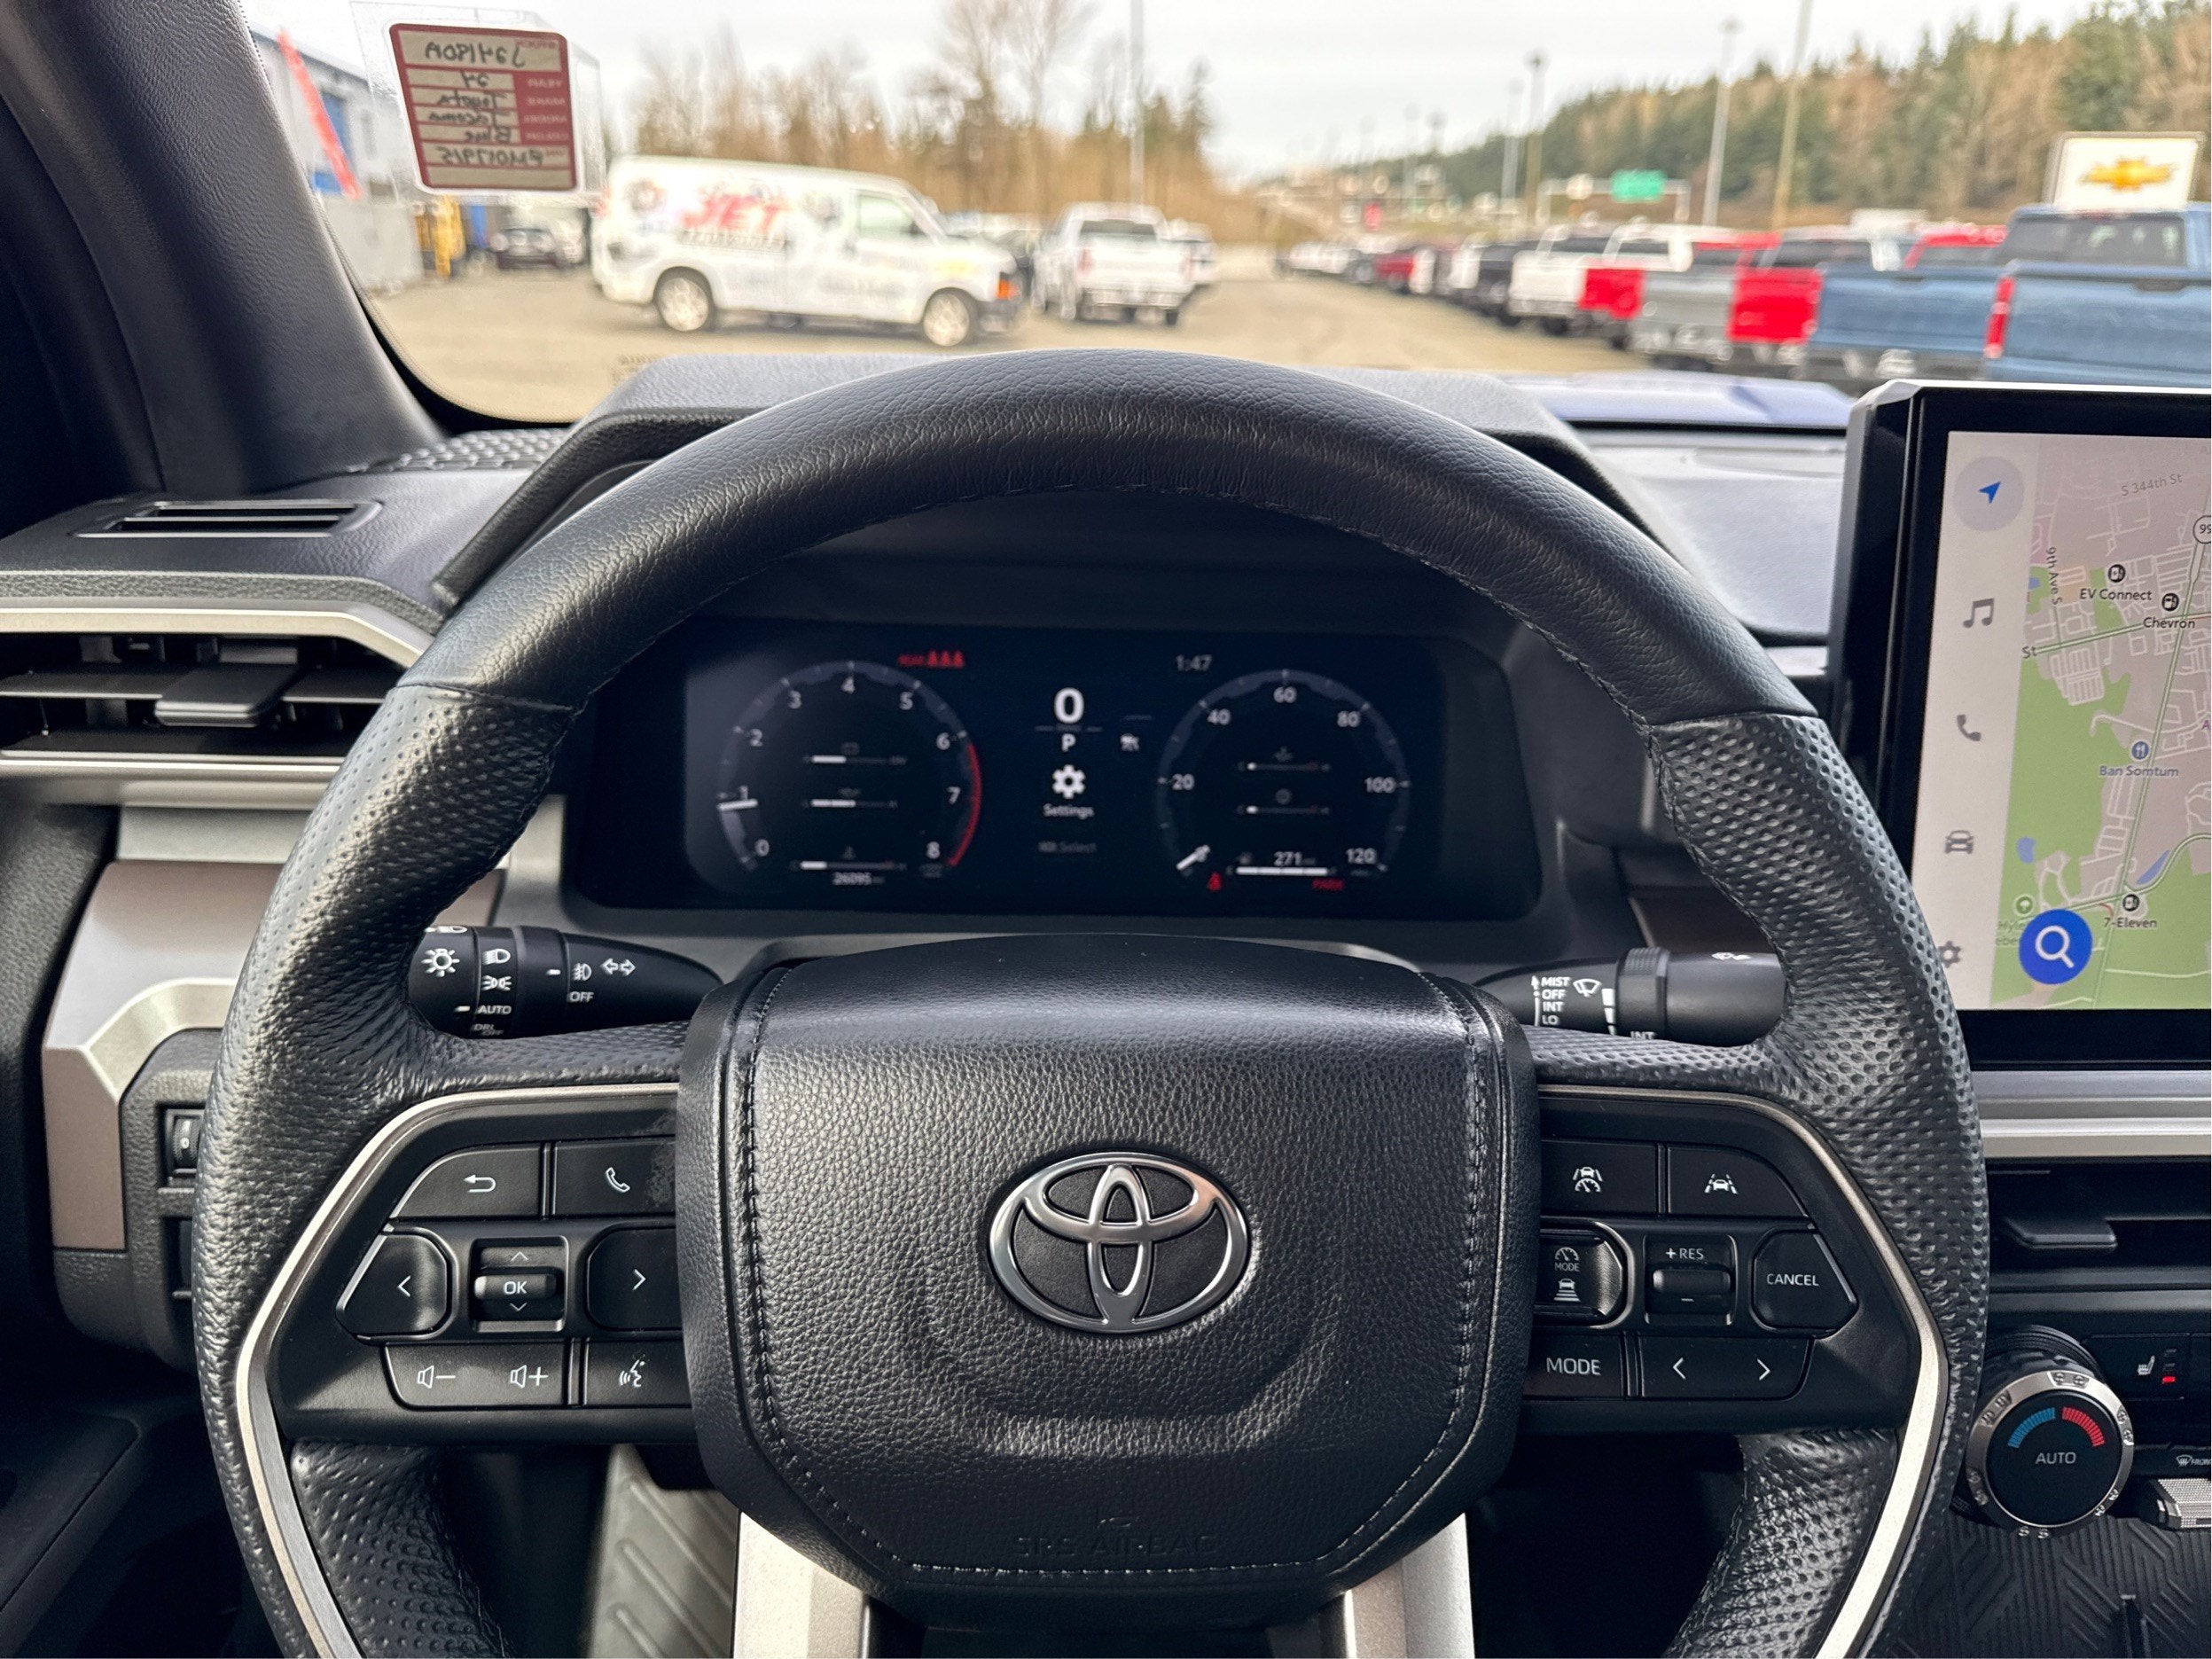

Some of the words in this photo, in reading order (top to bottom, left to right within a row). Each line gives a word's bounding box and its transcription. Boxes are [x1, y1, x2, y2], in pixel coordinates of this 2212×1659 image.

[2131, 477, 2167, 494] 344th
[2169, 473, 2183, 485] St
[2046, 546, 2057, 568] 9th
[2048, 572, 2059, 594] Ave
[2080, 589, 2099, 600] EV
[2100, 588, 2153, 601] Connect
[2143, 616, 2195, 629] Chevron
[2022, 646, 2037, 659] St
[841, 677, 855, 693] 4
[788, 690, 801, 708] 3
[899, 691, 913, 709] 5
[1273, 686, 1297, 703] 60
[1053, 686, 1084, 724] 0
[1207, 708, 1231, 725] 40
[1337, 710, 1361, 727] 80
[749, 728, 762, 747] 2
[936, 732, 950, 750] 6
[1061, 733, 1076, 752] P
[2099, 766, 2122, 777] Ban
[2126, 766, 2179, 777] Somtum
[1172, 773, 1195, 791] 20
[1364, 776, 1396, 793] 100
[946, 786, 961, 804] 7
[1043, 802, 1095, 820] Settings
[754, 839, 770, 857] 0
[926, 841, 941, 859] 8
[1346, 847, 1377, 865] 120
[1273, 851, 1303, 867] 271
[2104, 917, 2157, 928] 7-Eleven
[1541, 976, 1571, 987] MIST
[569, 991, 594, 1003] OFF
[1542, 989, 1567, 1000] OFF
[475, 1005, 512, 1015] AUTO
[1543, 1001, 1564, 1012] INT
[1542, 1014, 1559, 1025] LO
[1630, 1030, 1655, 1039] INT
[1554, 1263, 1580, 1272] MODE
[504, 1280, 528, 1295] OK
[1766, 1272, 1819, 1287] CANCEL
[1545, 1358, 1601, 1376] MODE
[2036, 1452, 2076, 1465] AUTO
